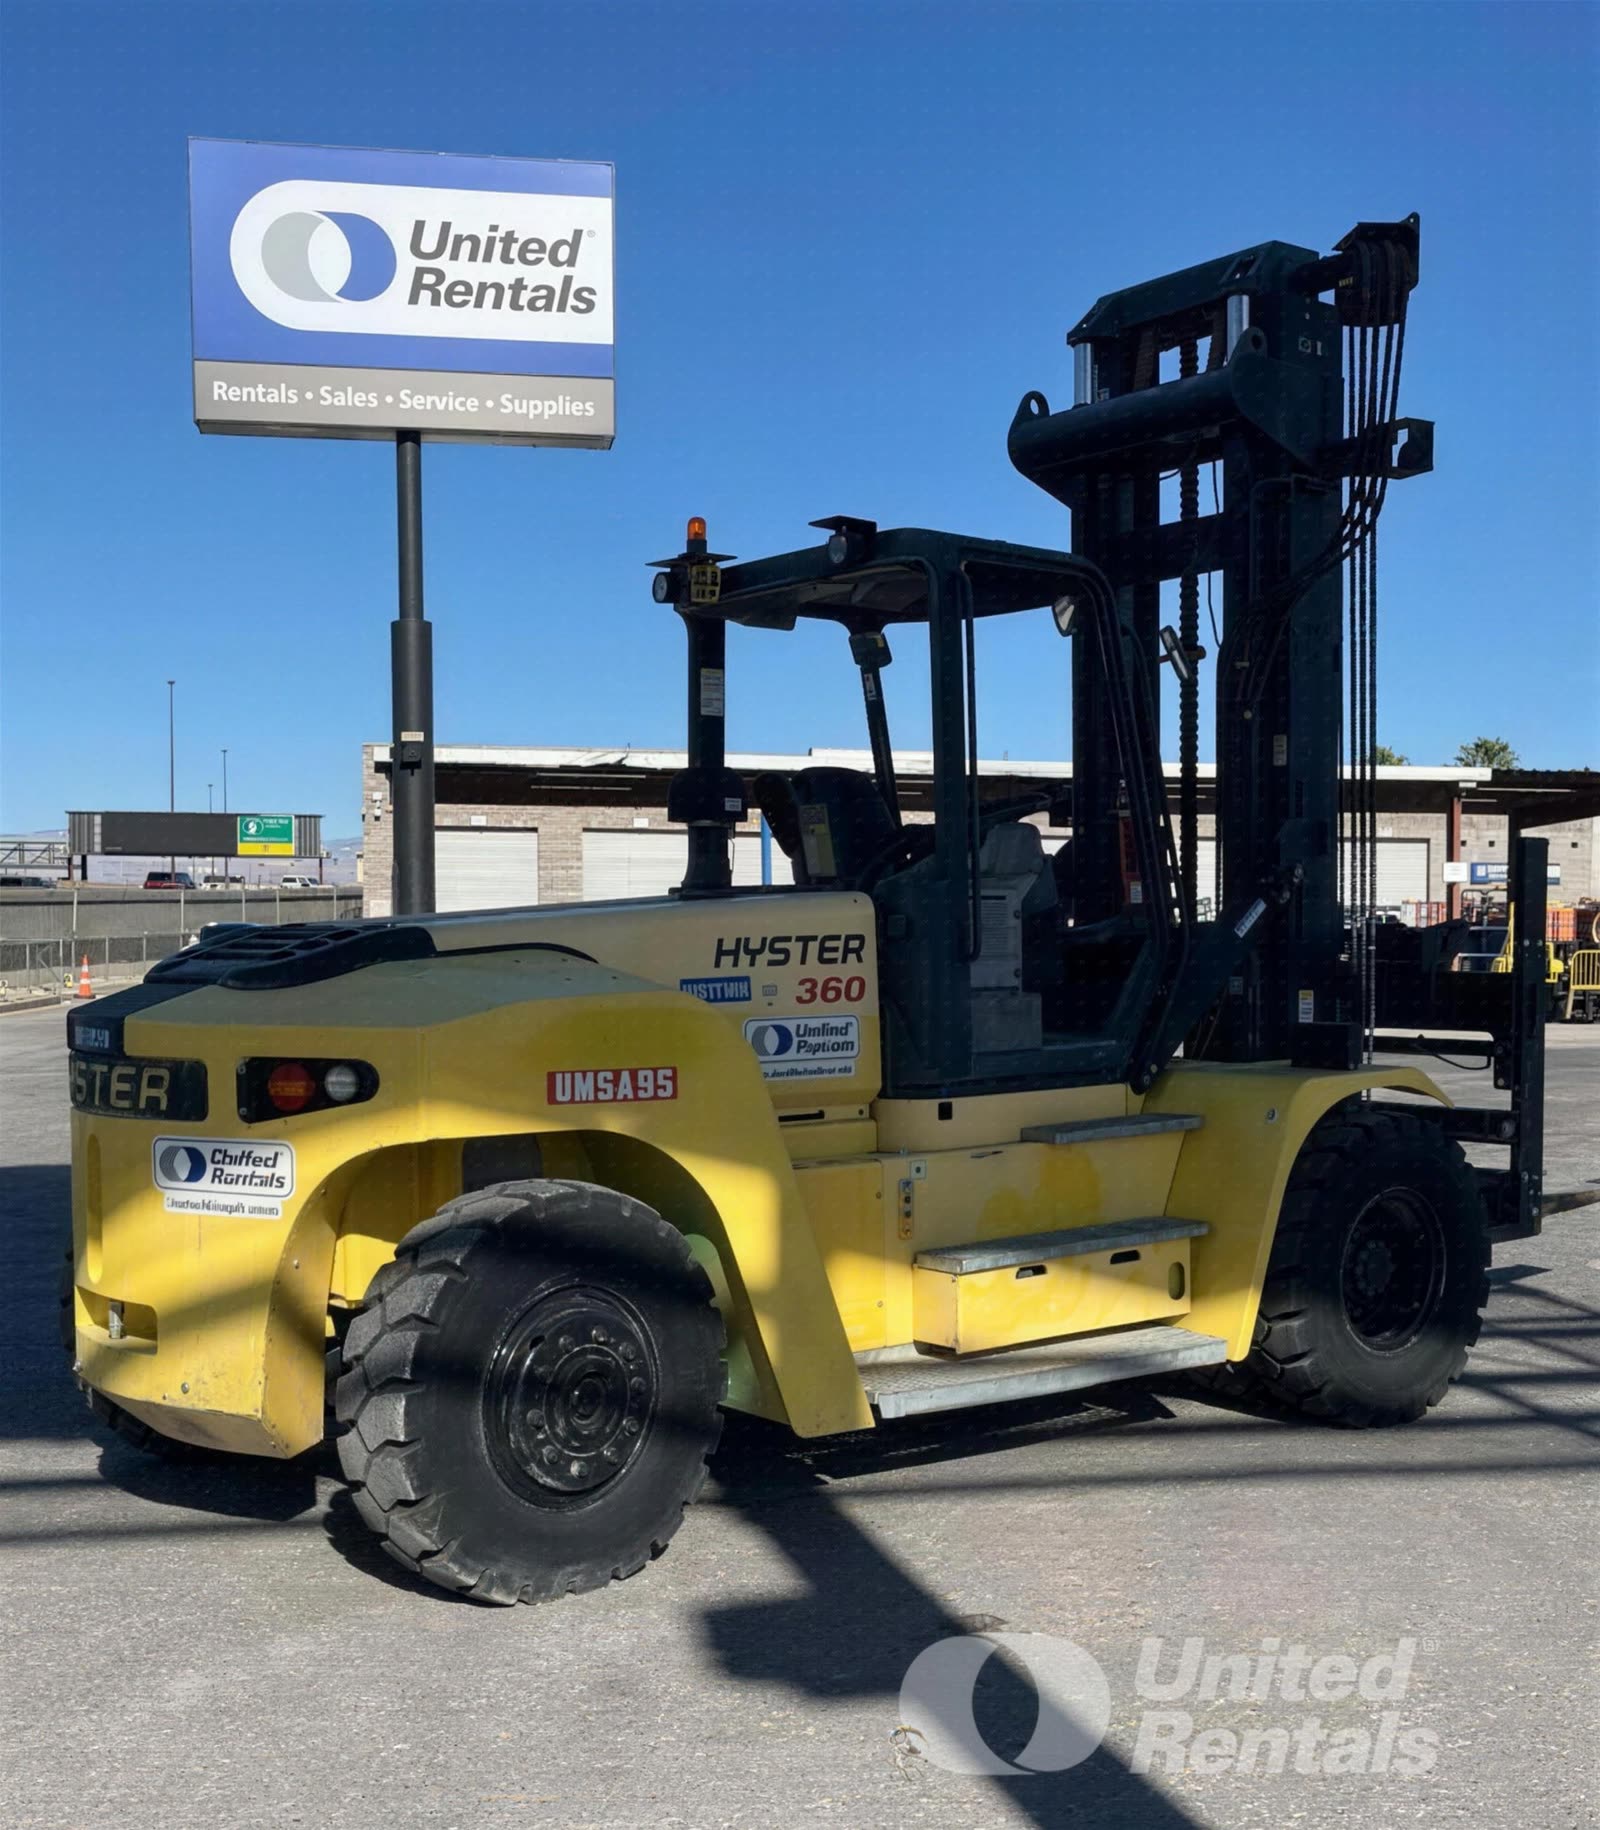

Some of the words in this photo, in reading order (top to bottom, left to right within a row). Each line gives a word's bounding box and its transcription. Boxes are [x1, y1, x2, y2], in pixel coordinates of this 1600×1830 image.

[408, 219, 584, 268] United
[407, 266, 598, 315] Rentals
[212, 381, 299, 405] Rentals
[319, 386, 379, 408] Sales
[399, 389, 480, 413] Service
[499, 394, 596, 419] Supplies
[714, 934, 866, 968] HYSTER
[795, 975, 866, 1005] 360
[72, 1059, 171, 1111] STER
